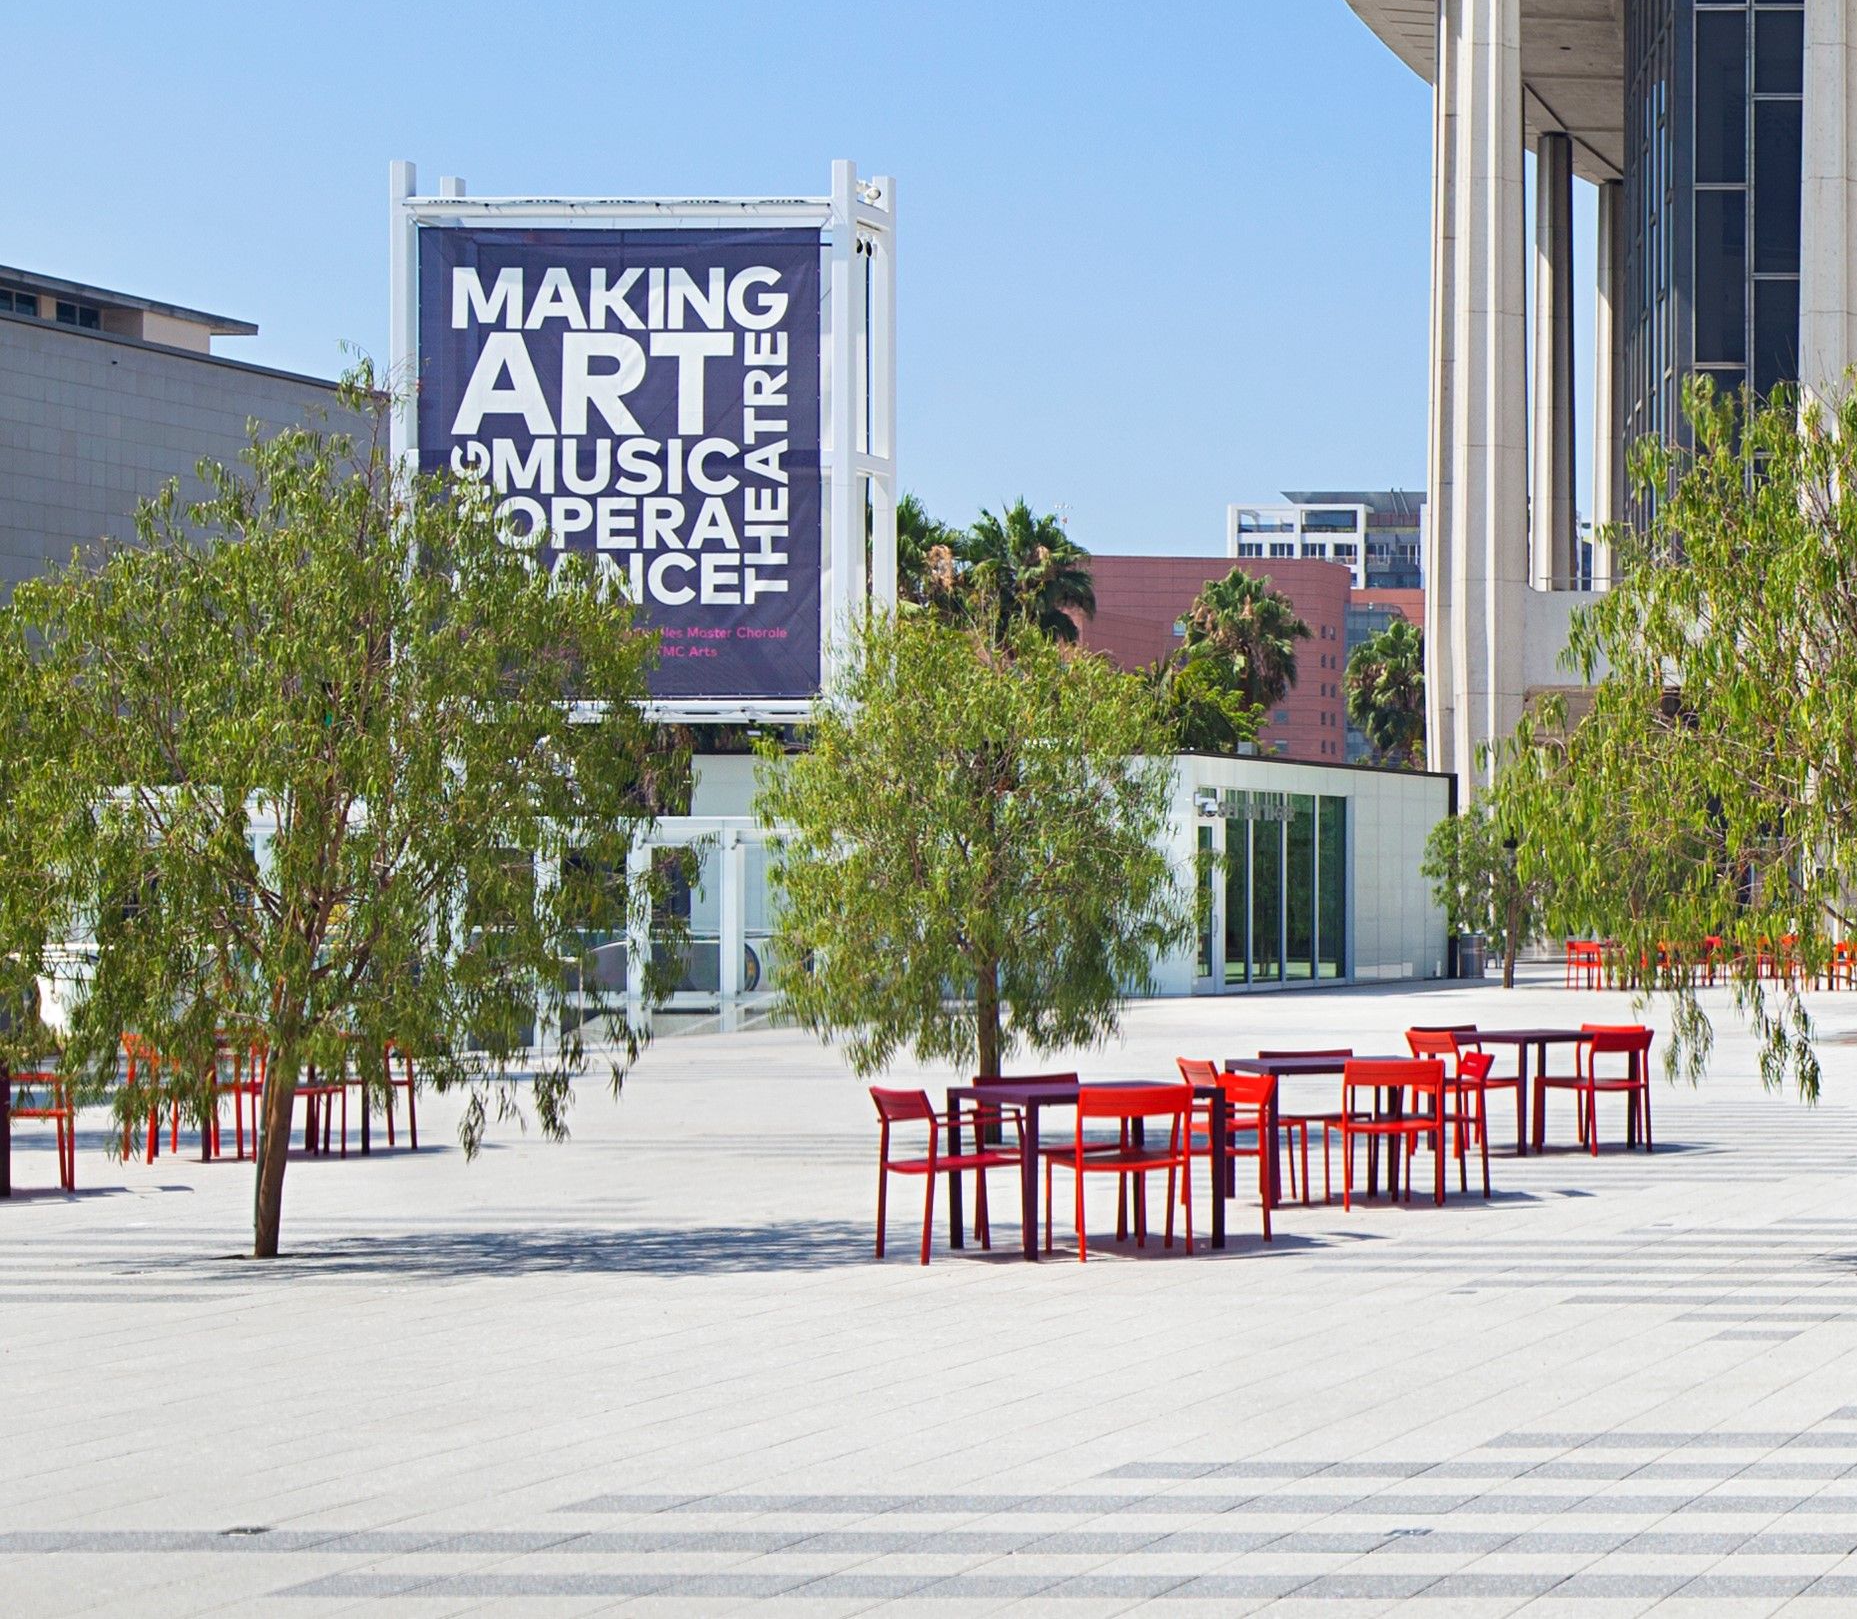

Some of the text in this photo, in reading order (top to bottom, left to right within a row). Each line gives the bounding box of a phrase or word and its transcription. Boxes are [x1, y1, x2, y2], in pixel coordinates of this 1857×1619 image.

[451, 266, 789, 330] MAKING
[450, 331, 734, 436] ART
[492, 437, 740, 495] MUSIC
[743, 331, 789, 605] THEATRE
[493, 496, 739, 550] OPERA
[687, 627, 732, 639] Master
[736, 627, 788, 639] Chorale
[689, 646, 718, 657] Arts
